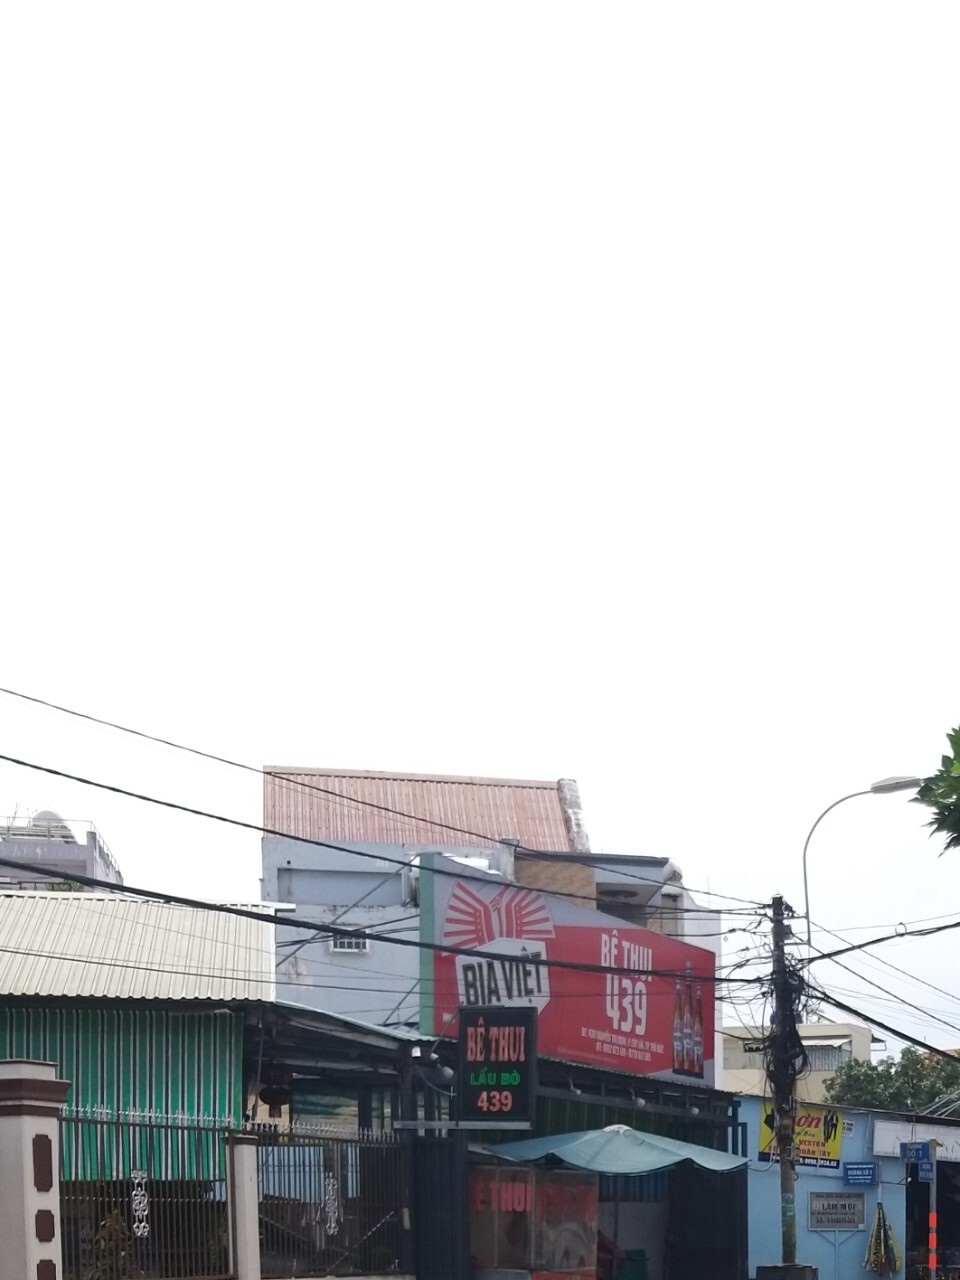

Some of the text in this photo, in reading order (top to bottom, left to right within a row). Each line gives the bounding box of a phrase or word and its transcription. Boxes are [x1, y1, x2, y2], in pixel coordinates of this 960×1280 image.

[462, 945, 543, 1006] BIA VIỆT
[601, 929, 653, 982] BÊ THUI
[606, 972, 648, 1036] 439
[466, 1016, 526, 1062] BÊ THUI
[477, 1090, 513, 1112] 439
[501, 1070, 521, 1086] BÒ
